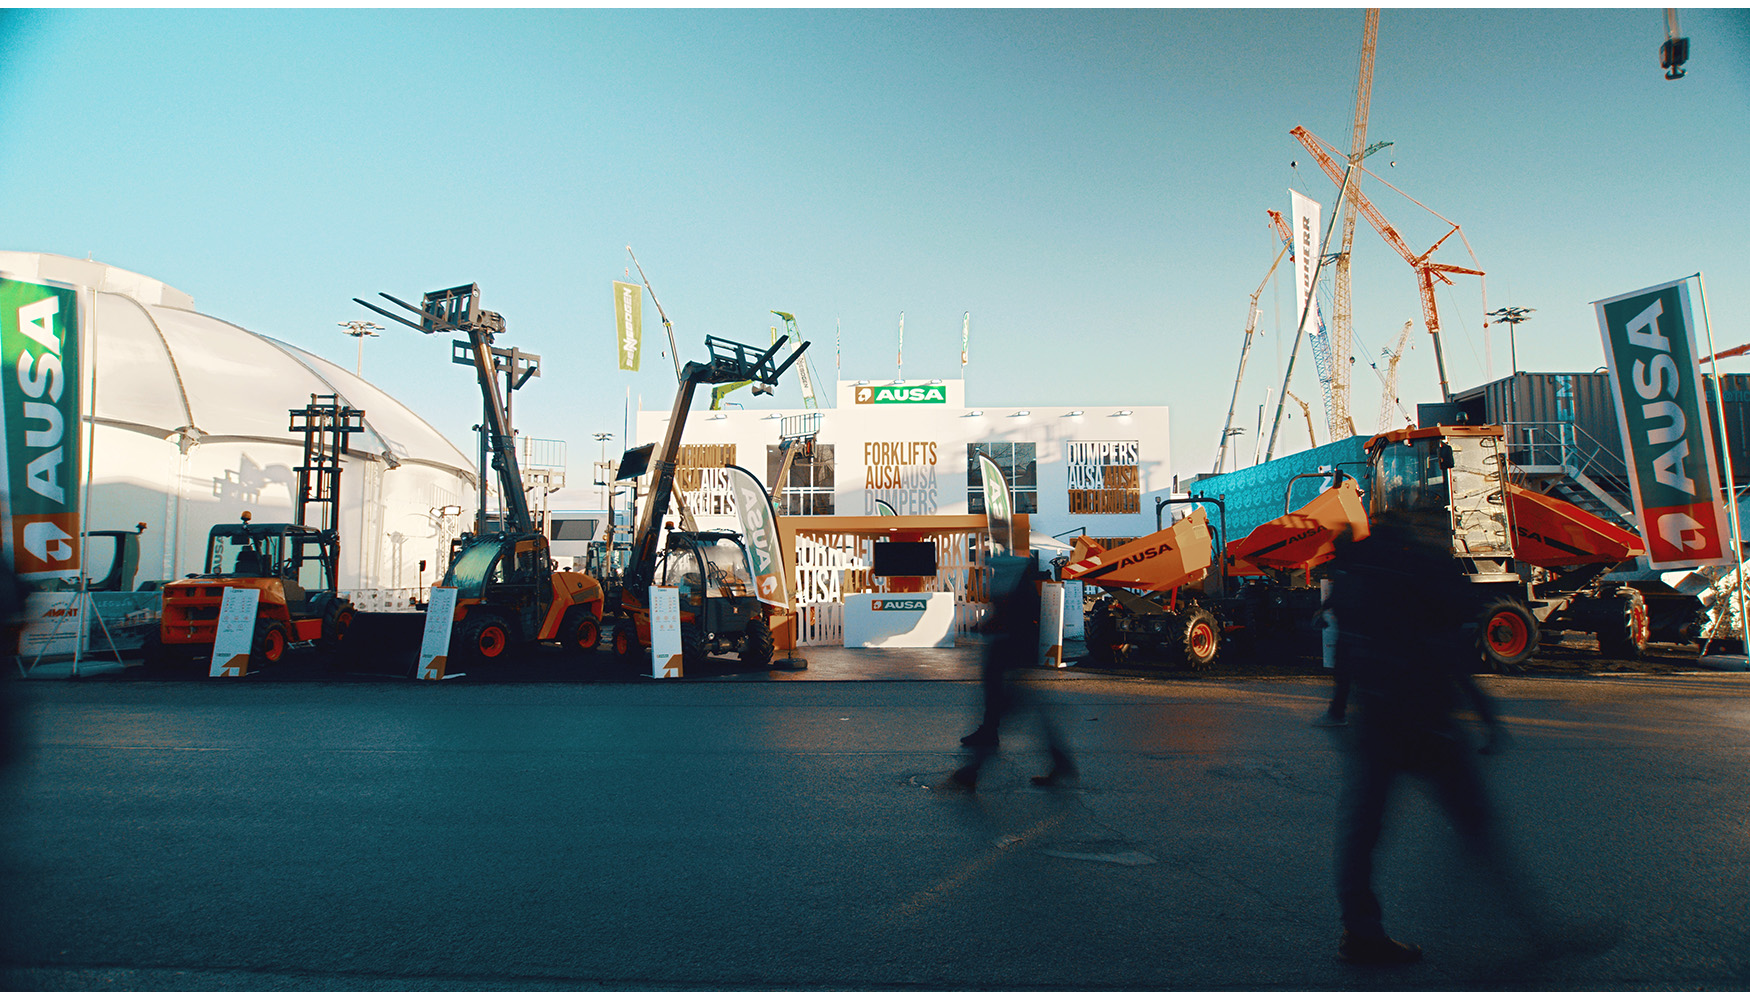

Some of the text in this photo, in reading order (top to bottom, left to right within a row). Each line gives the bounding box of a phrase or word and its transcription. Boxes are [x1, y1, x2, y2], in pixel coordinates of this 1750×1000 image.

[17, 295, 65, 505] AUSA
[876, 388, 944, 401] AUSA
[1626, 298, 1696, 496] AUSA
[675, 444, 736, 468] LEHANDLER
[864, 441, 937, 466] FORKLIFTS
[1068, 442, 1138, 465] DUMPERS
[865, 465, 938, 489] AUSA AUSA
[1068, 465, 1140, 489] AUSA AUSA
[1068, 489, 1141, 514] TELEHANDLER
[1289, 525, 1327, 544] AUSA
[1121, 544, 1173, 569] AUSA
[884, 601, 925, 609] AUSA
